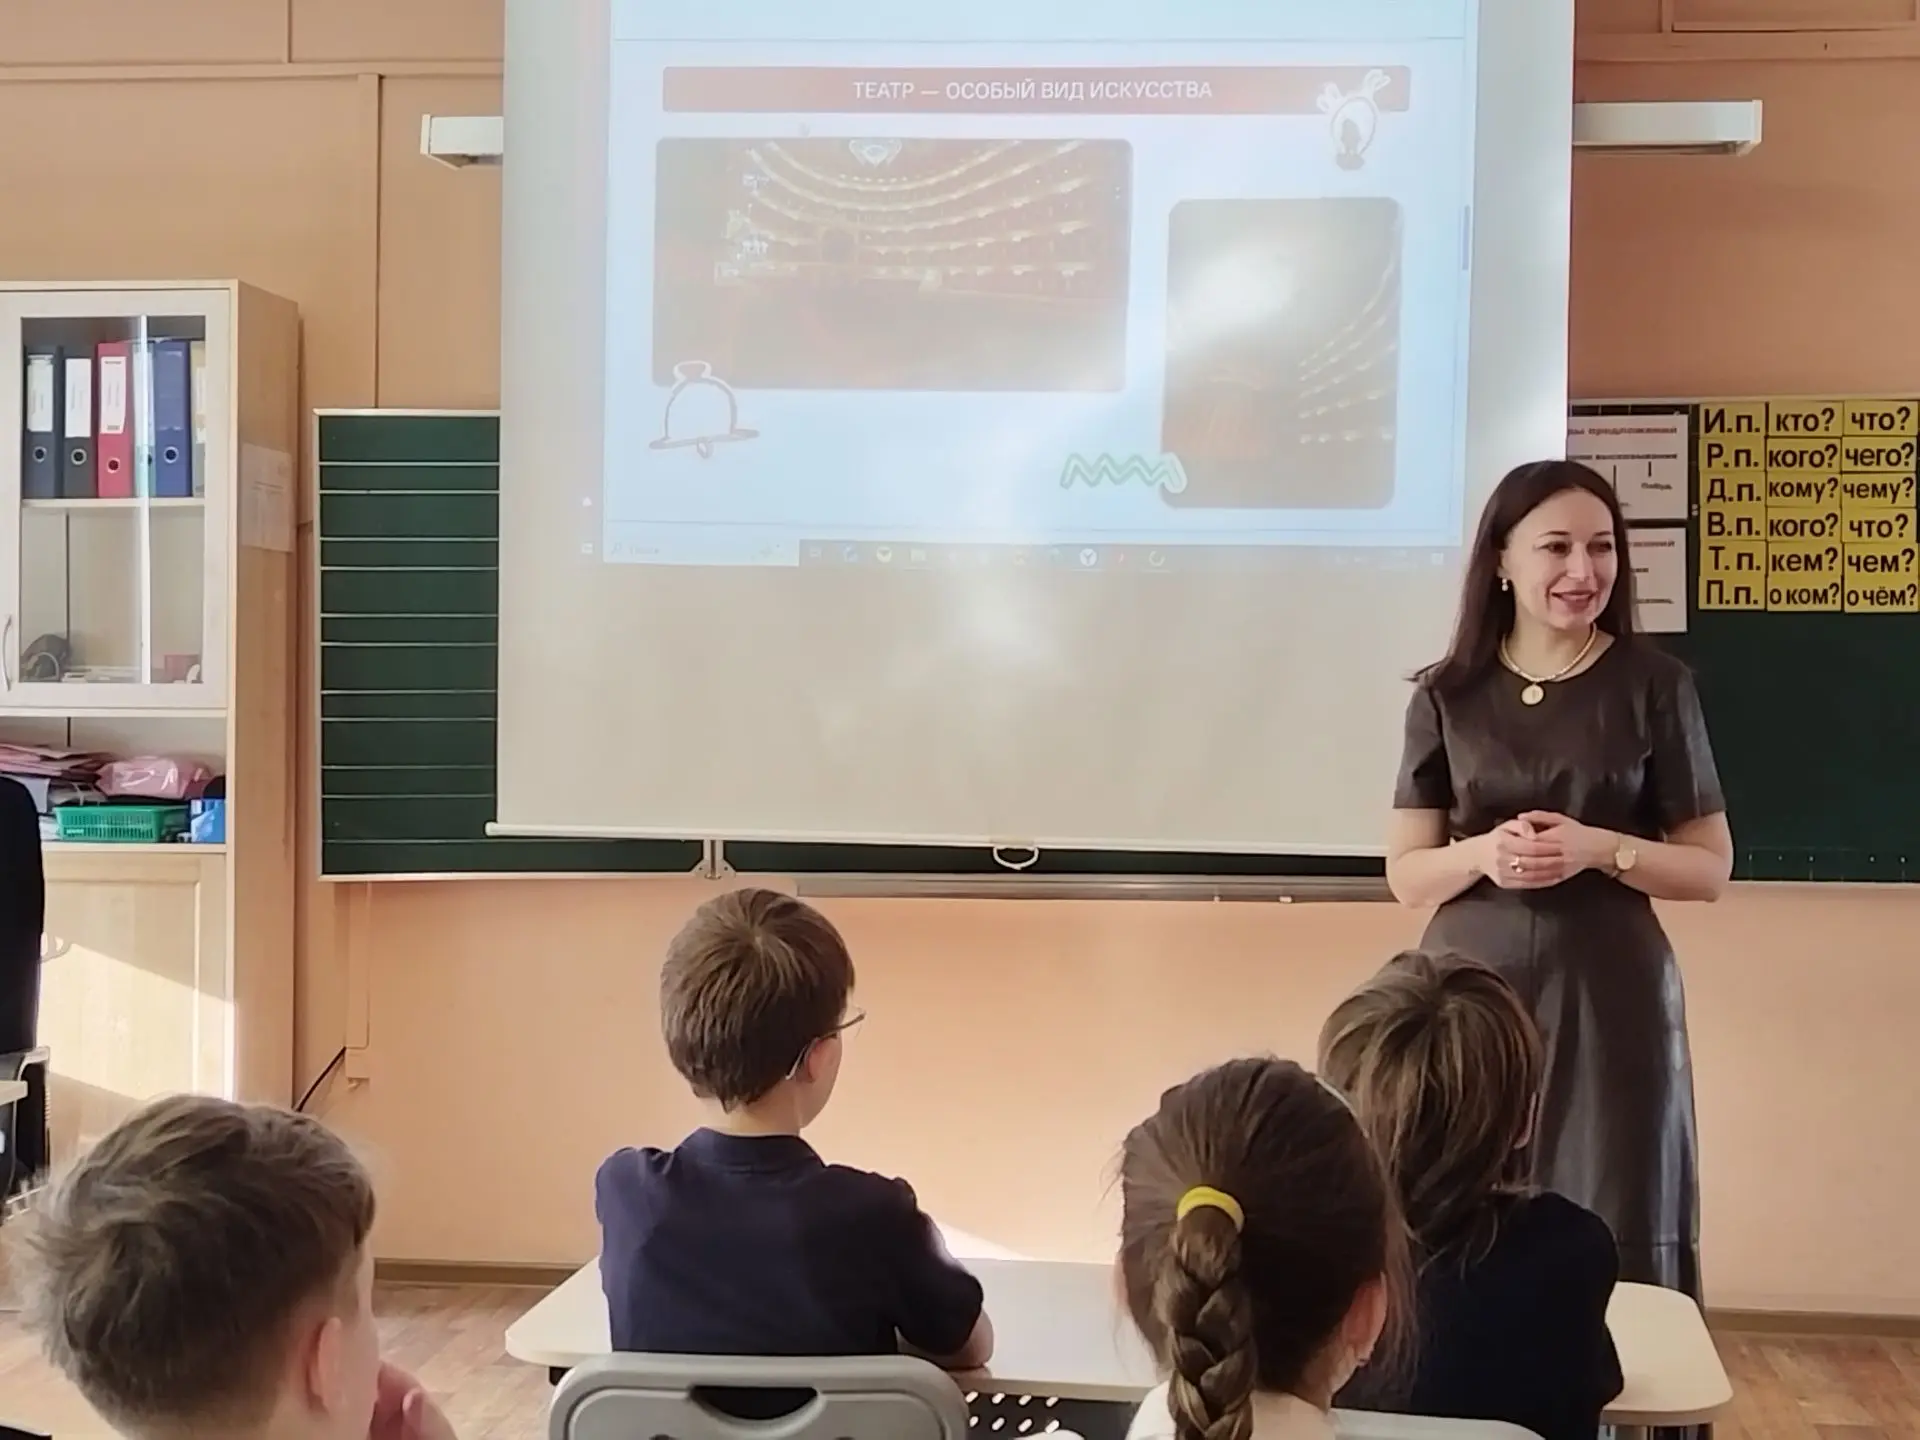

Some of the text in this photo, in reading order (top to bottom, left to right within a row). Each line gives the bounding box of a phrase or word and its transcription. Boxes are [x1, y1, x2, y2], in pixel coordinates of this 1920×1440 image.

[853, 82, 914, 98] ТЕАТР
[947, 79, 1035, 99] ОСОБЫЙ
[1041, 82, 1084, 101] ВИД
[1090, 81, 1212, 98] ИСКУССТВА
[1776, 407, 1834, 432] кто?
[1851, 406, 1910, 431] что?
[1769, 444, 1838, 468] кого?
[1845, 442, 1913, 467] чего?
[1769, 477, 1838, 502] кому?
[1843, 477, 1914, 502] чему?
[1769, 513, 1838, 537] кого?
[1850, 513, 1908, 537] что?
[1771, 547, 1838, 571] кем?
[1847, 548, 1915, 572] чем?
[1787, 583, 1840, 605] ком?
[1863, 583, 1917, 605] чём?
